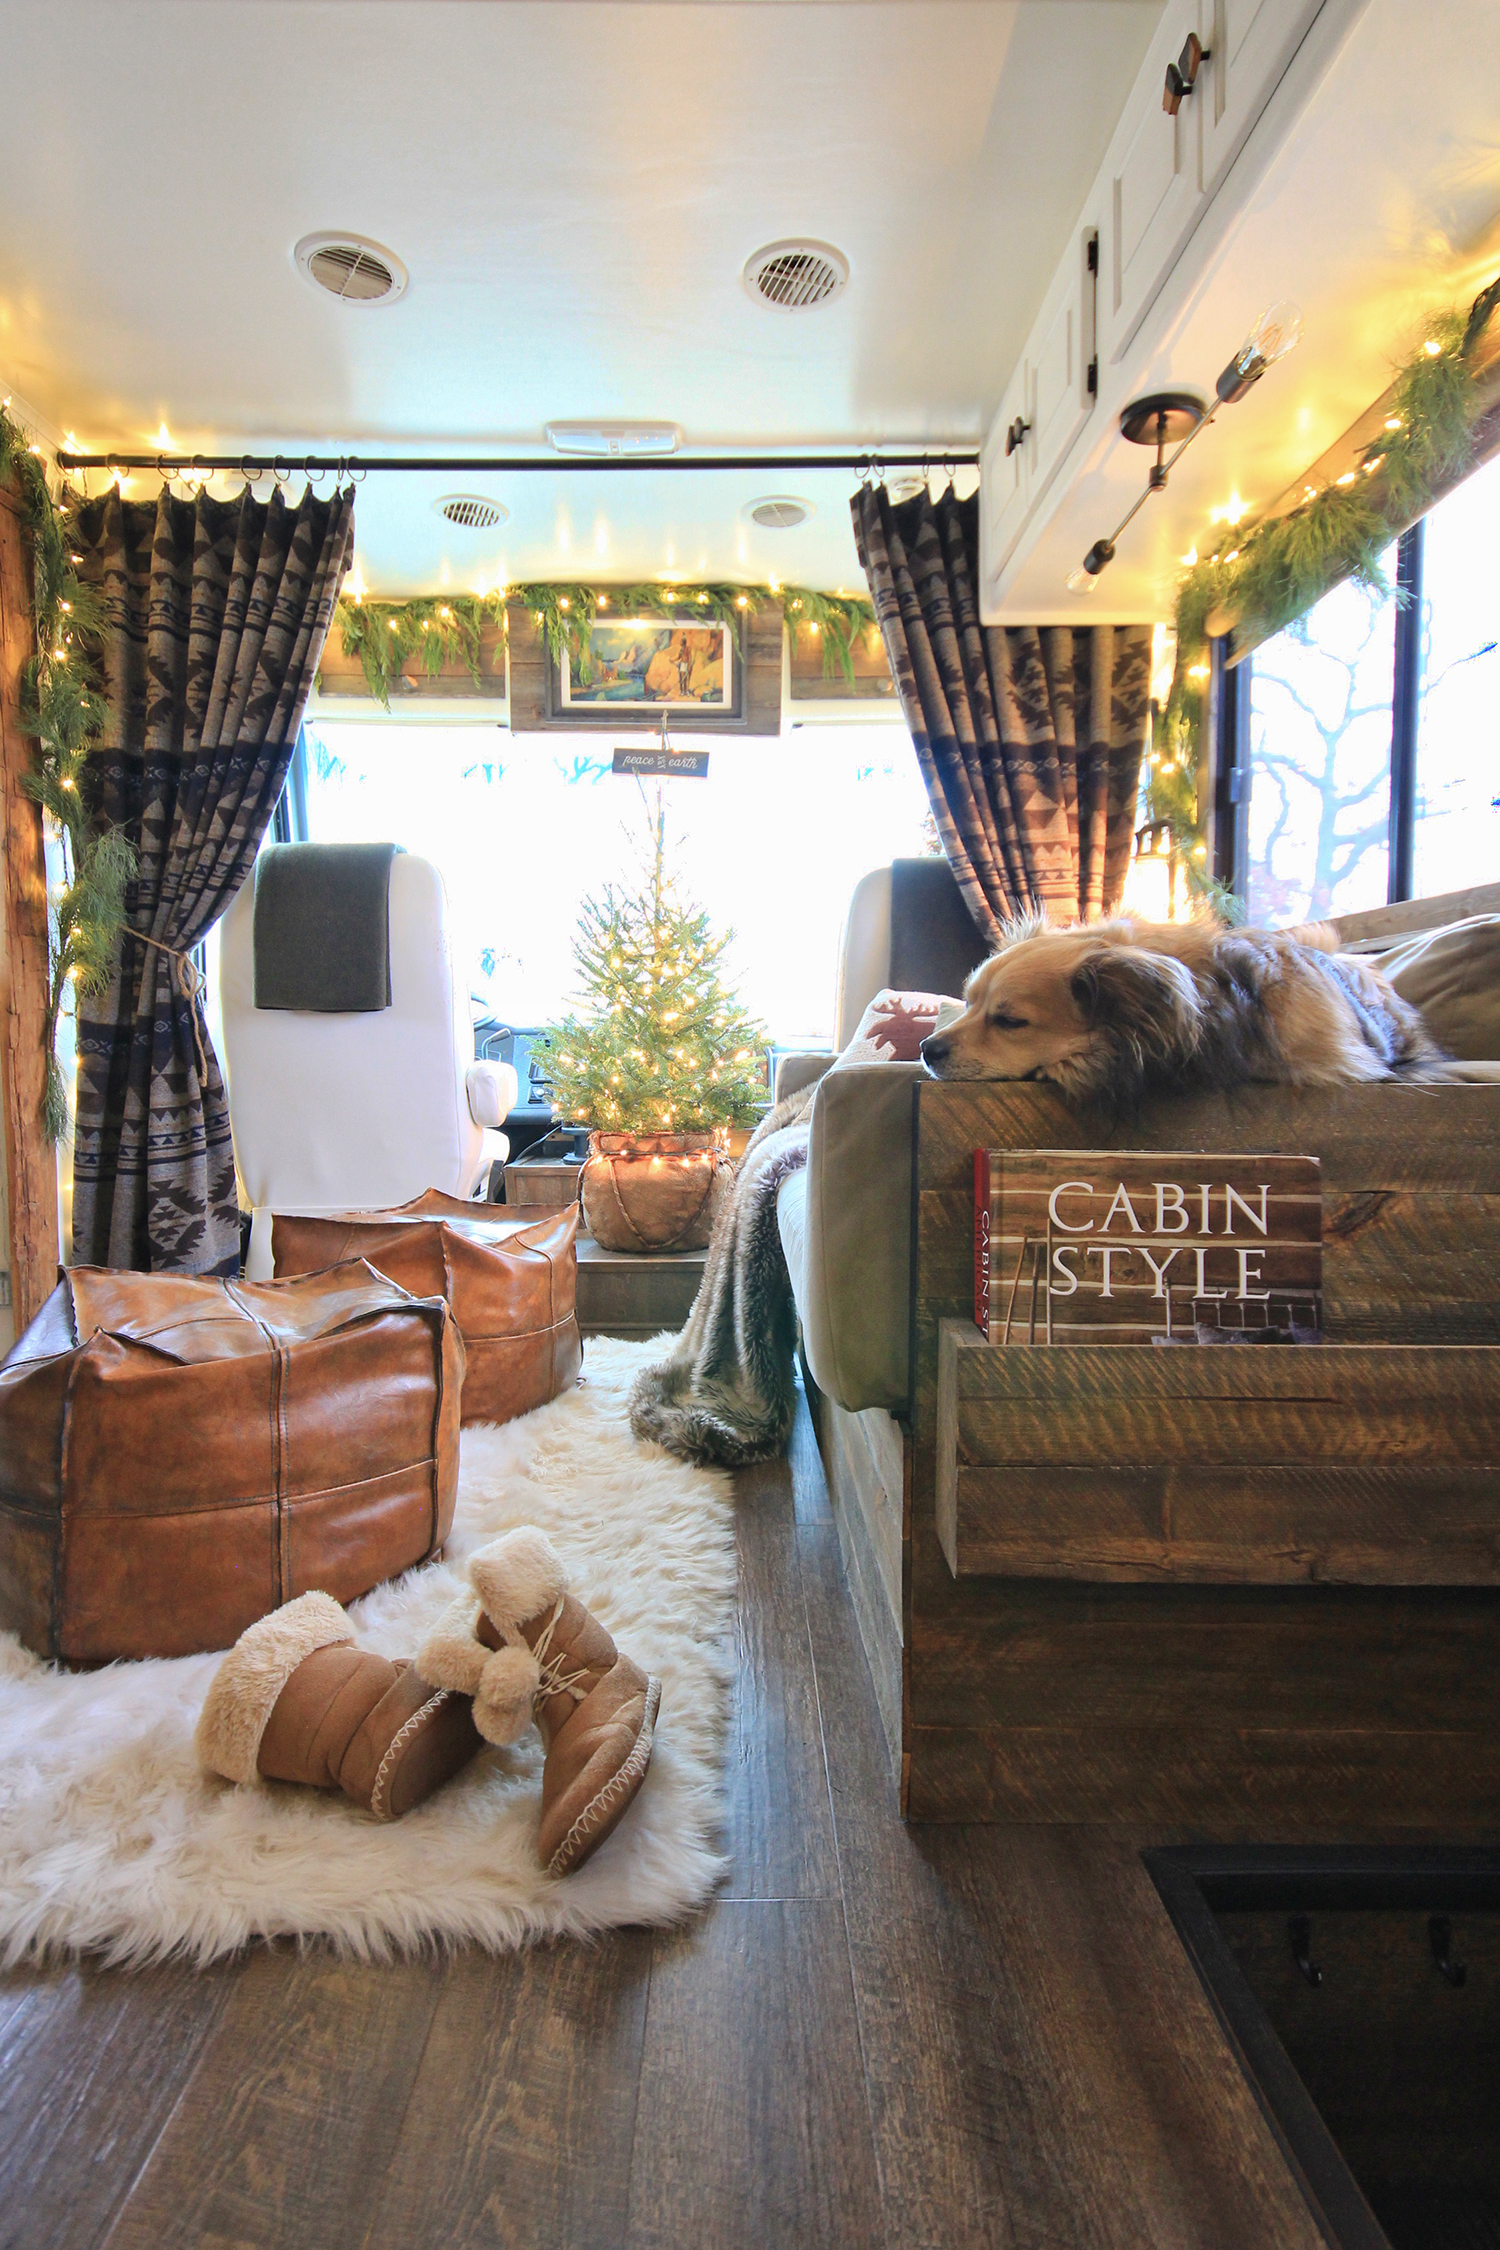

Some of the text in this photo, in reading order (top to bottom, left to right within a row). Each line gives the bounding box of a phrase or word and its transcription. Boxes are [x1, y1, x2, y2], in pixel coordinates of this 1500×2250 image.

[622, 755, 654, 767] peace
[668, 757, 698, 769] earth
[1048, 1181, 1271, 1236] CABIN
[981, 1210, 990, 1297] CABIN
[1049, 1246, 1271, 1300] STYLE
